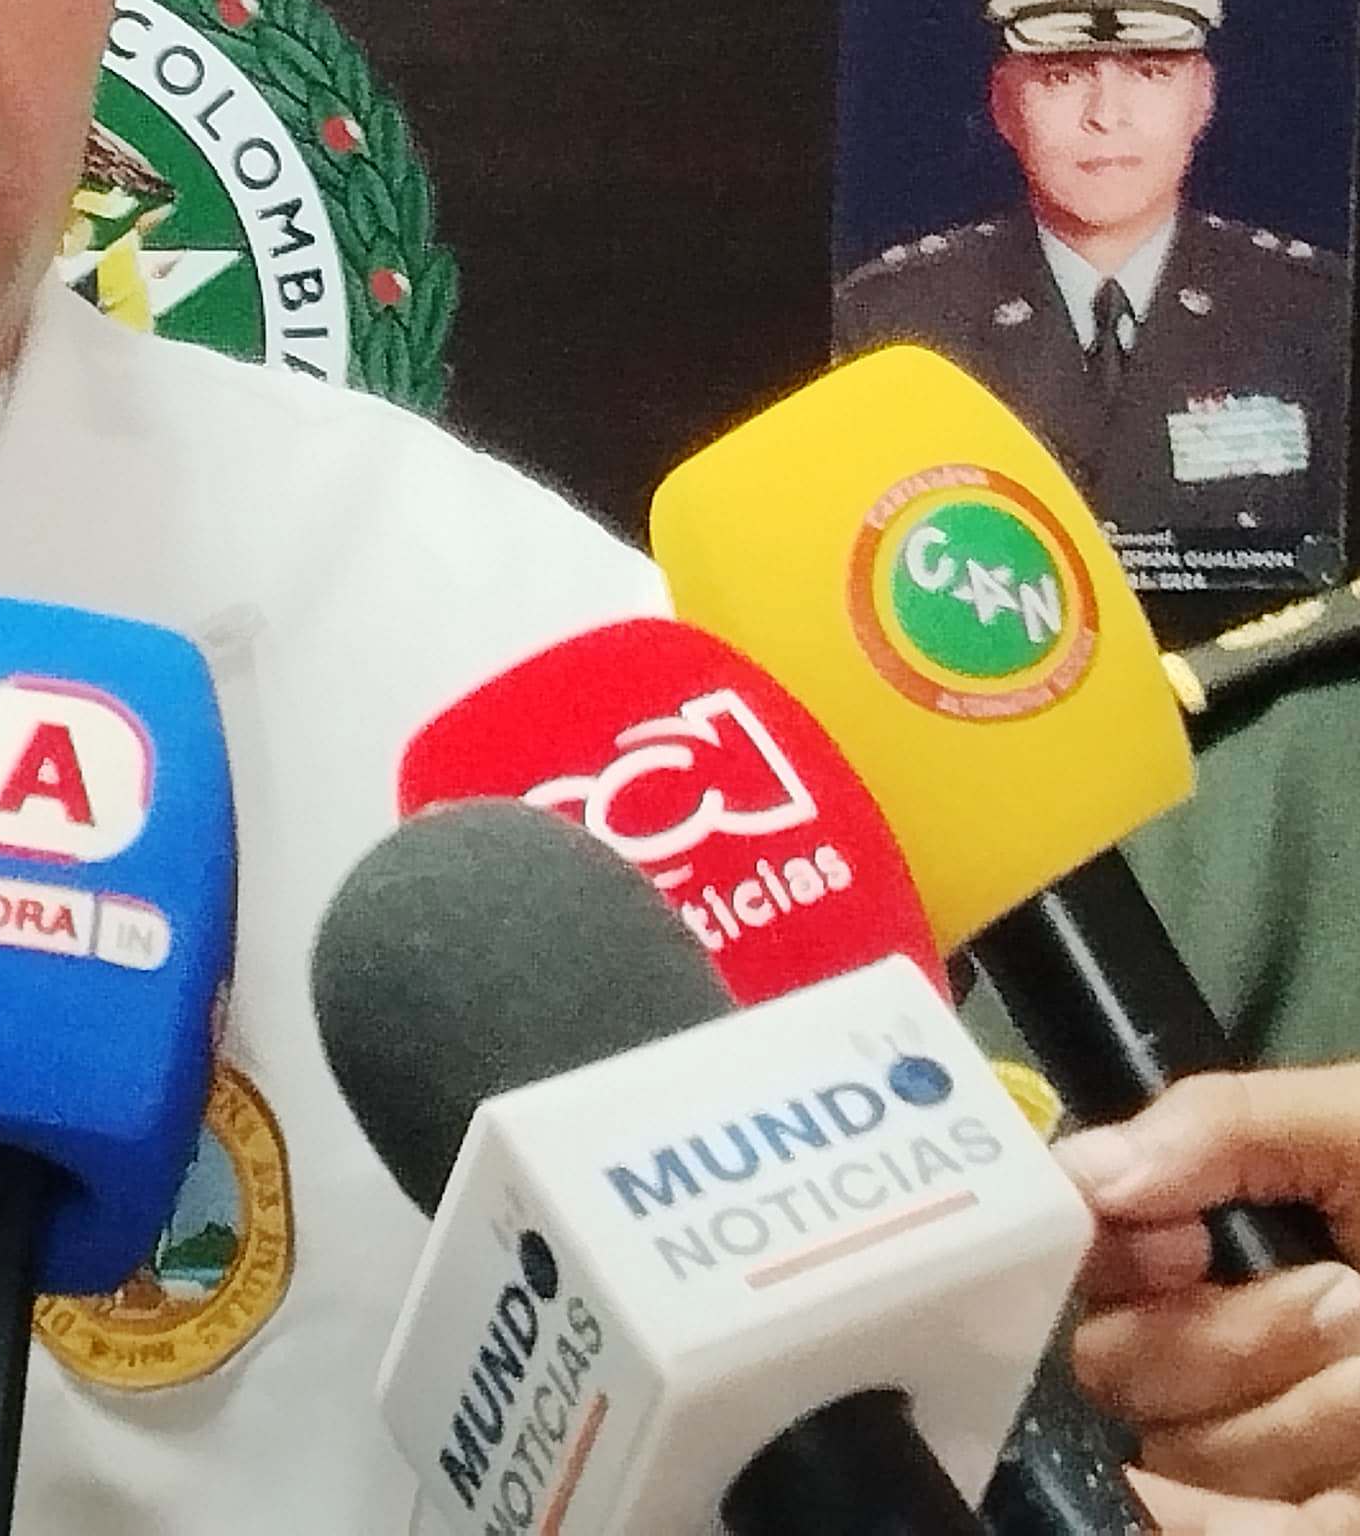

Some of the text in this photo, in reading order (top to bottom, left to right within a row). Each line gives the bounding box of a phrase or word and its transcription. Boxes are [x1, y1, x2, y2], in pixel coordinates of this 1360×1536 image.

[680, 844, 854, 952] ticias
[603, 1054, 955, 1219] MUNDO
[653, 1115, 1004, 1282] NOTICIAS
[438, 1228, 559, 1511] MUNDO
